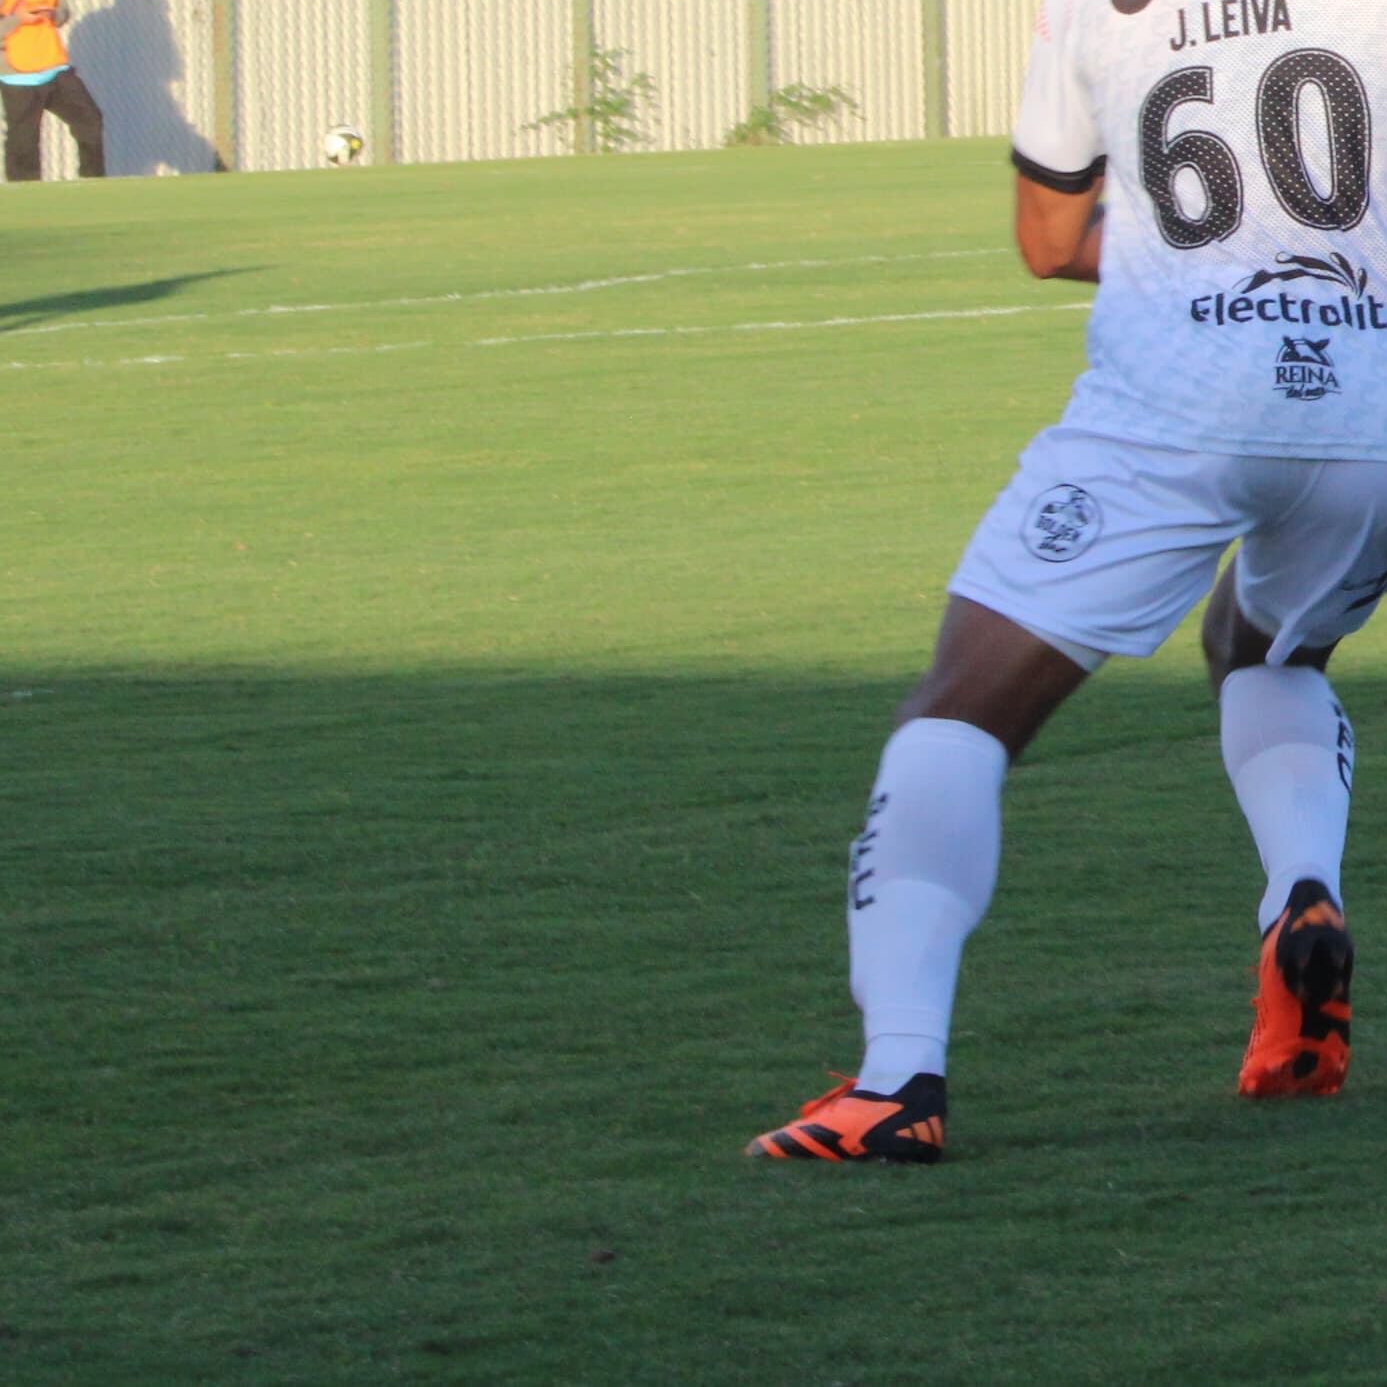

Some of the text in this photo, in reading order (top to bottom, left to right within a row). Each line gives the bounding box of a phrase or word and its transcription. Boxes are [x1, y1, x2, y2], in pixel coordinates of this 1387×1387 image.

[1169, 8, 1198, 52] J.
[1138, 47, 1372, 250] 60
[1273, 365, 1340, 389] REINA
